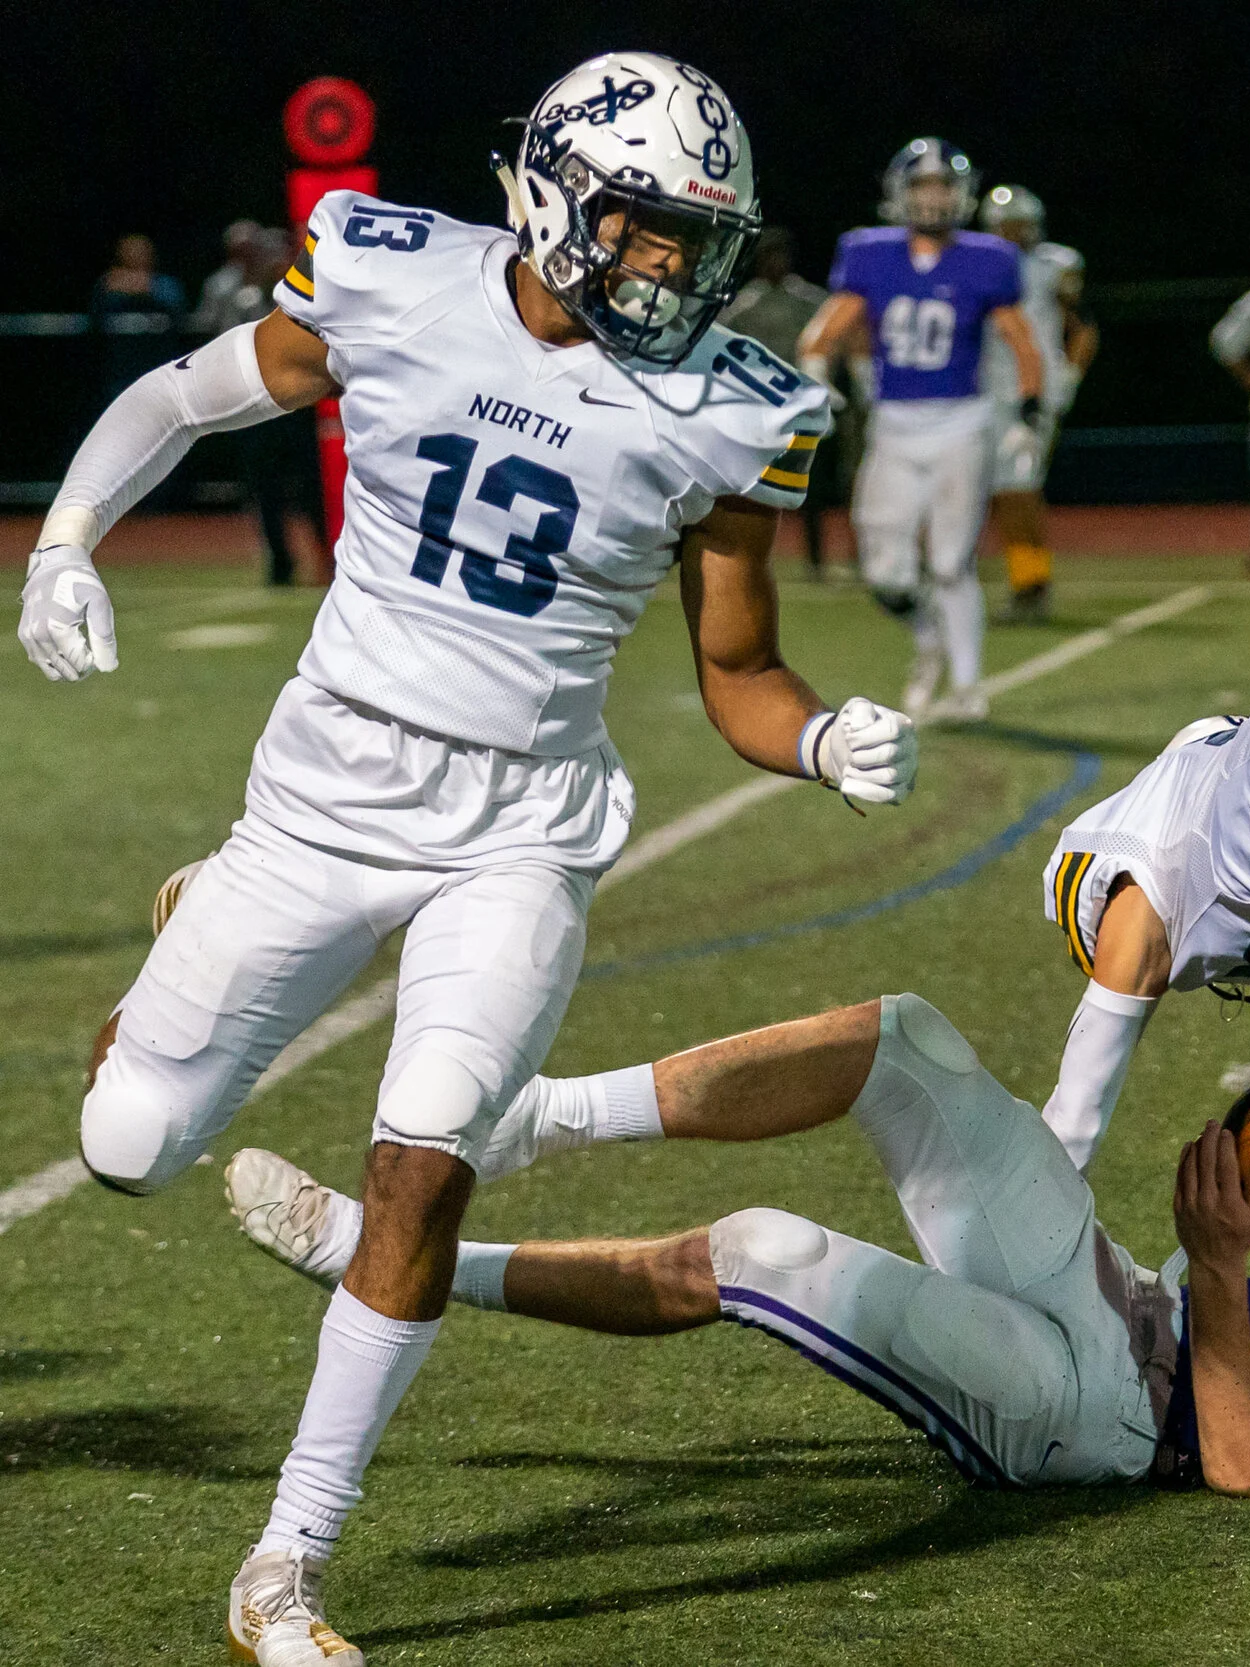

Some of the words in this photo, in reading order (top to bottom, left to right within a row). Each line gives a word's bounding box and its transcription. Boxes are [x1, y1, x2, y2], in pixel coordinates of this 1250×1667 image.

[687, 180, 737, 205] Riddell
[343, 204, 435, 252] 13
[881, 294, 957, 371] 40
[711, 338, 801, 408] 13
[468, 393, 573, 449] NORTH
[410, 432, 581, 618] 13
[611, 796, 632, 823] ebok
